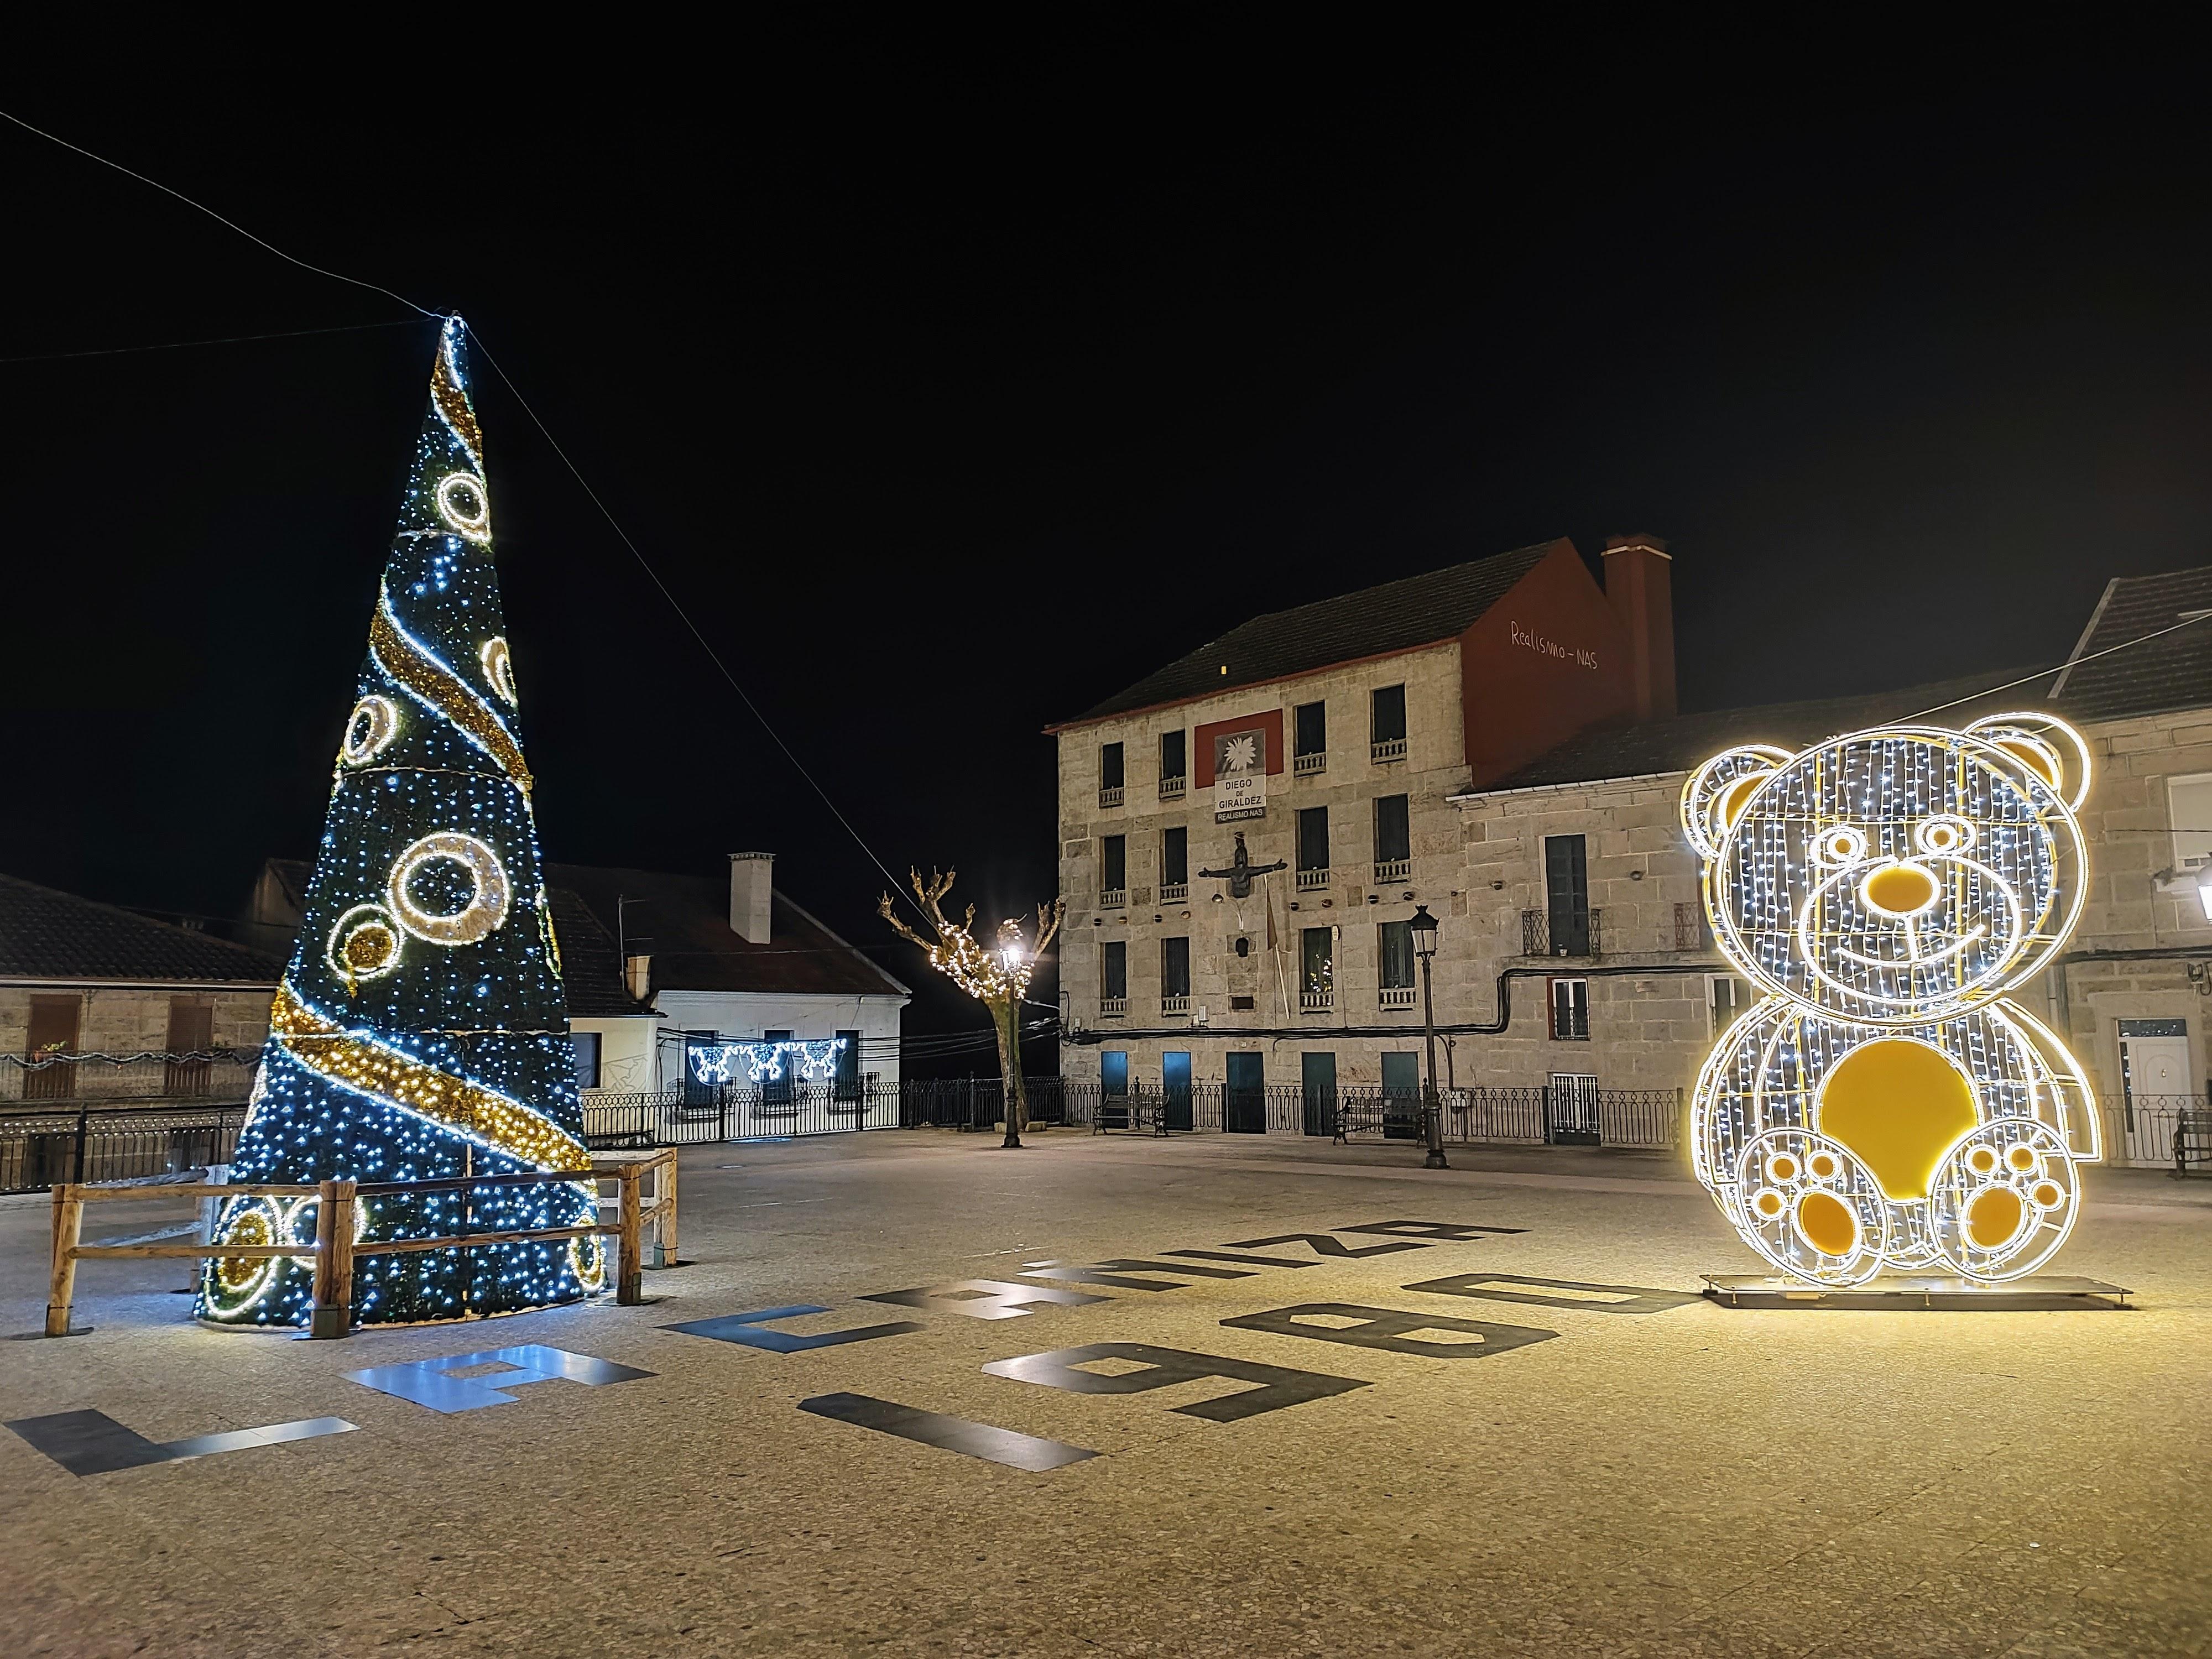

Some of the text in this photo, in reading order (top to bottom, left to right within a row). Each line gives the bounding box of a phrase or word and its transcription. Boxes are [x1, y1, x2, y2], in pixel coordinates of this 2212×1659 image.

[1225, 779, 1252, 790] DIEGO
[1219, 796, 1261, 808] GIRALDEZ
[1218, 808, 1263, 821] REALISMO NAS
[796, 1273, 1710, 1473] 1980
[3, 1344, 661, 1477] LA
